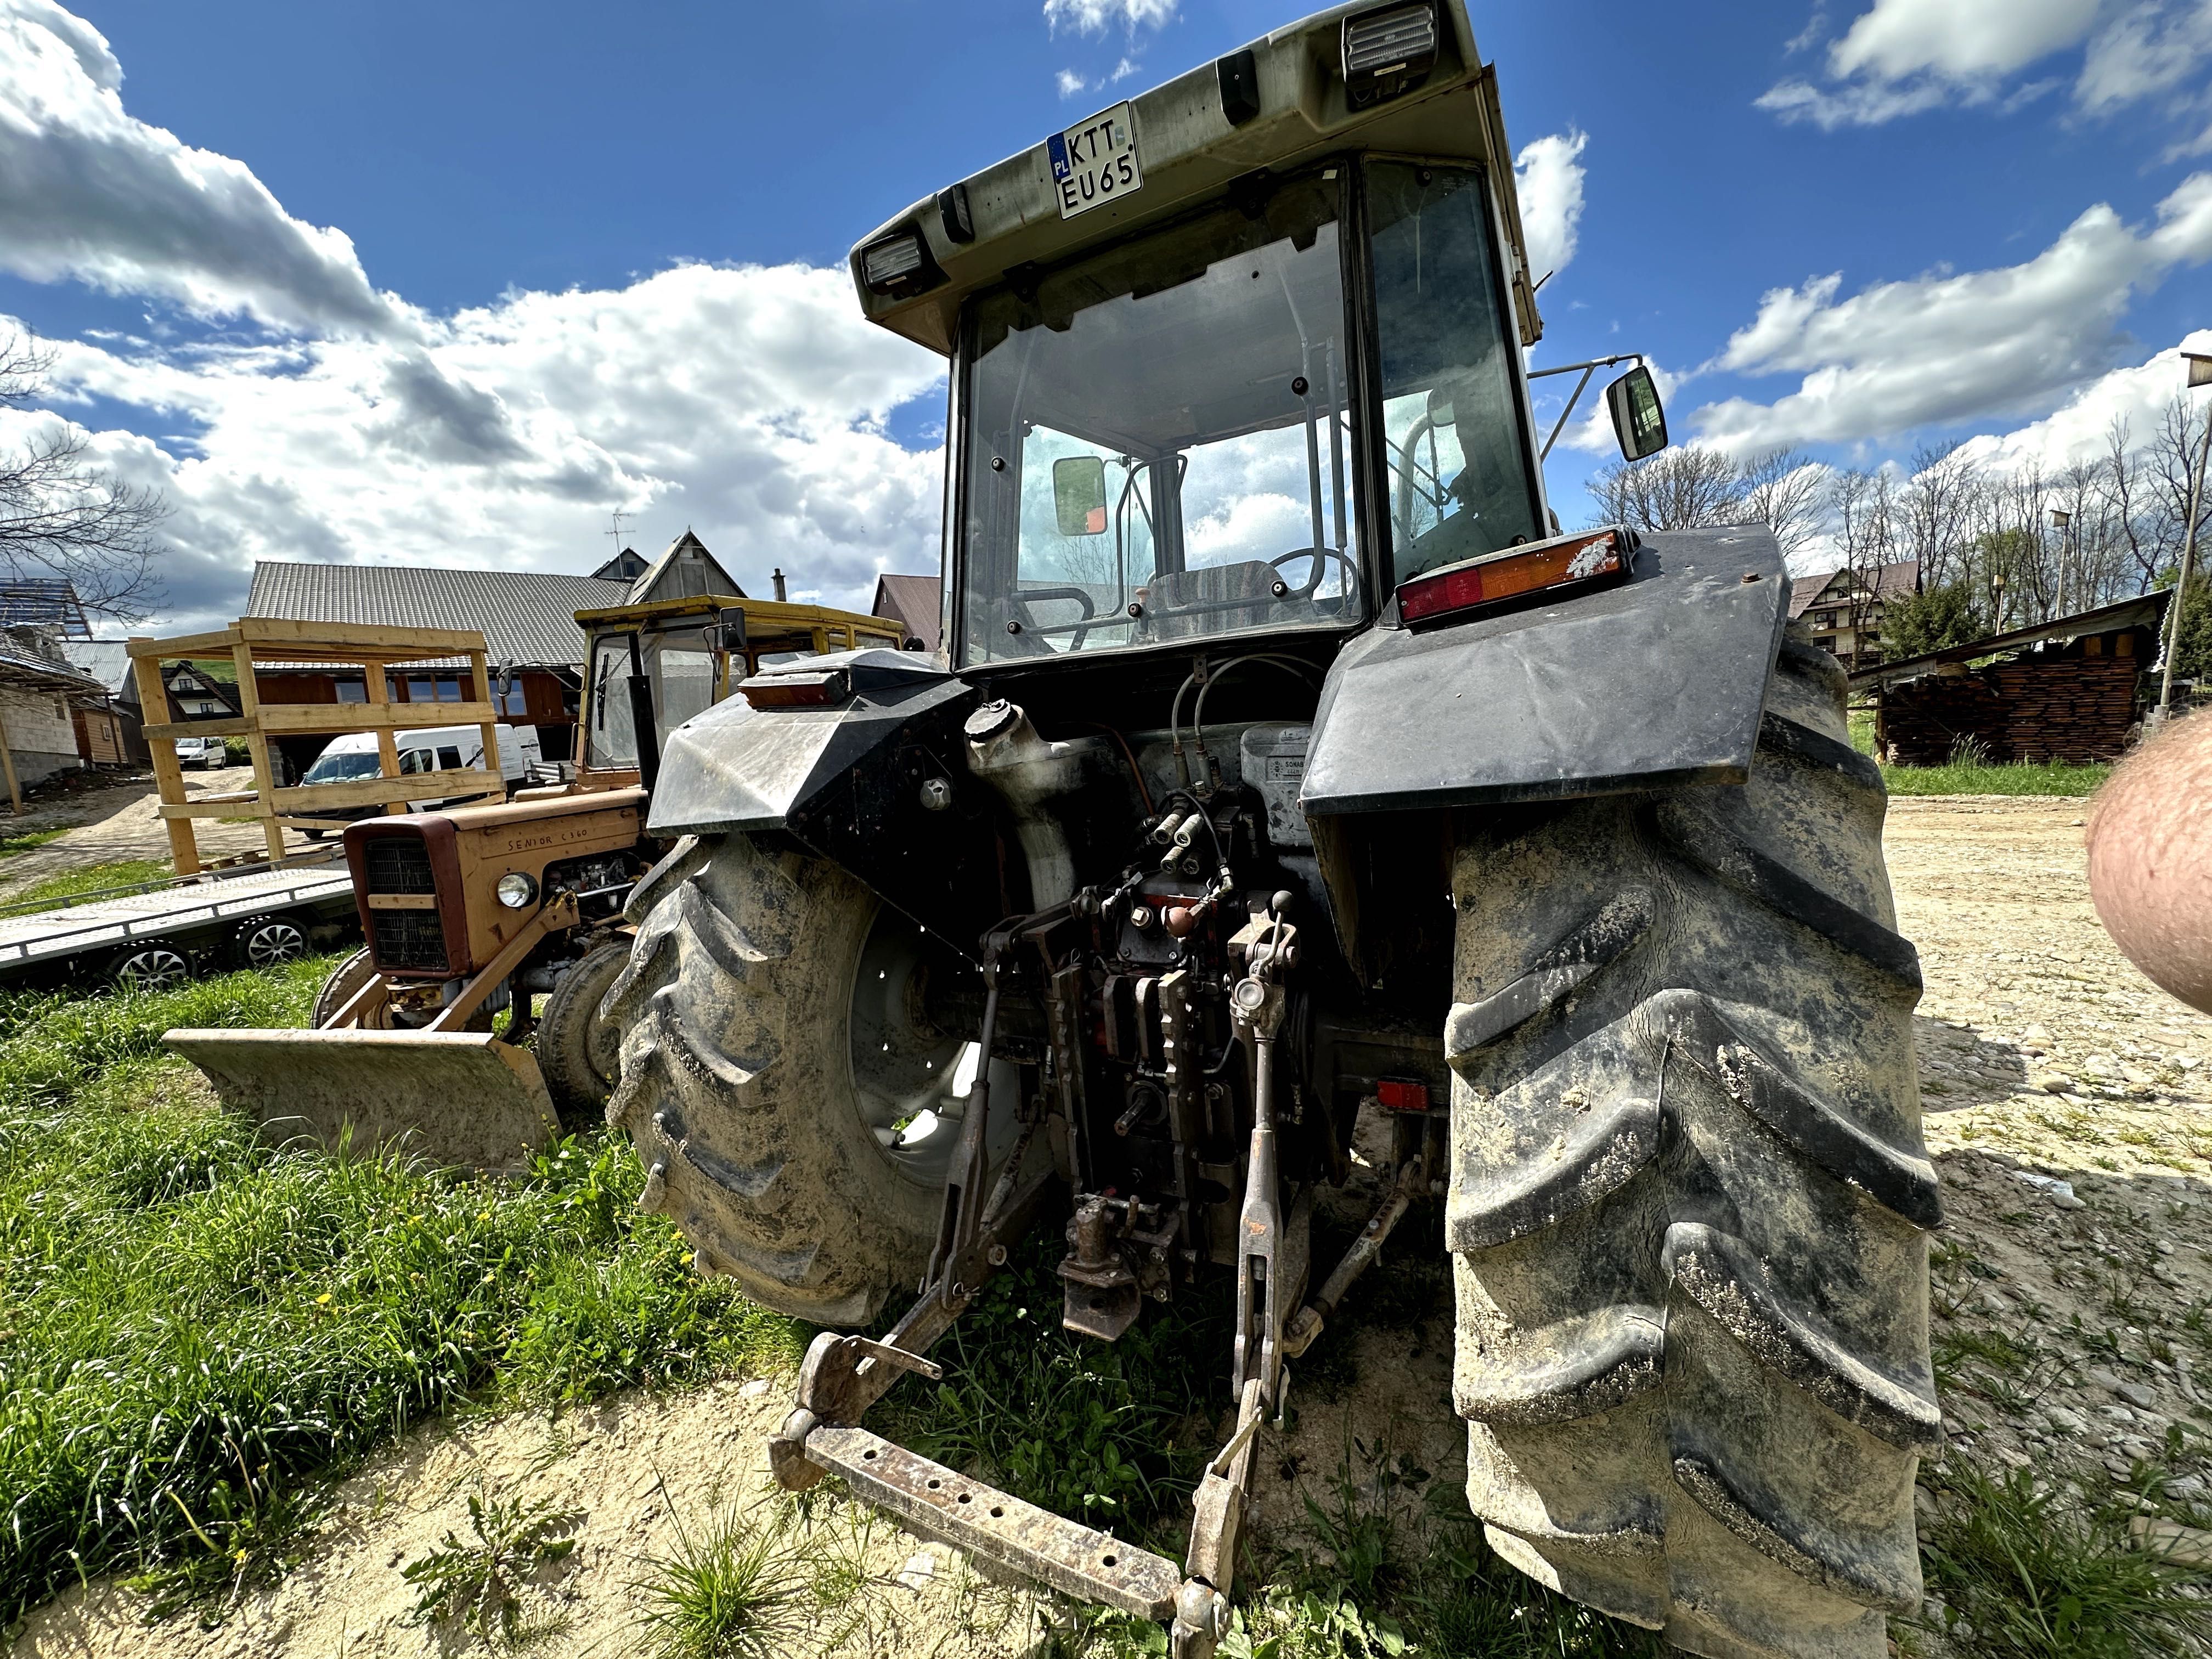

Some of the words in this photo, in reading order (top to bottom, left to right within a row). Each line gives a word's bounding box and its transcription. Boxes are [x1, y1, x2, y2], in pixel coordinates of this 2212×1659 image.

[1068, 119, 1113, 167] KTT
[1054, 160, 1069, 176] PL
[1061, 154, 1132, 209] EU65
[509, 836, 552, 851] SENIOR
